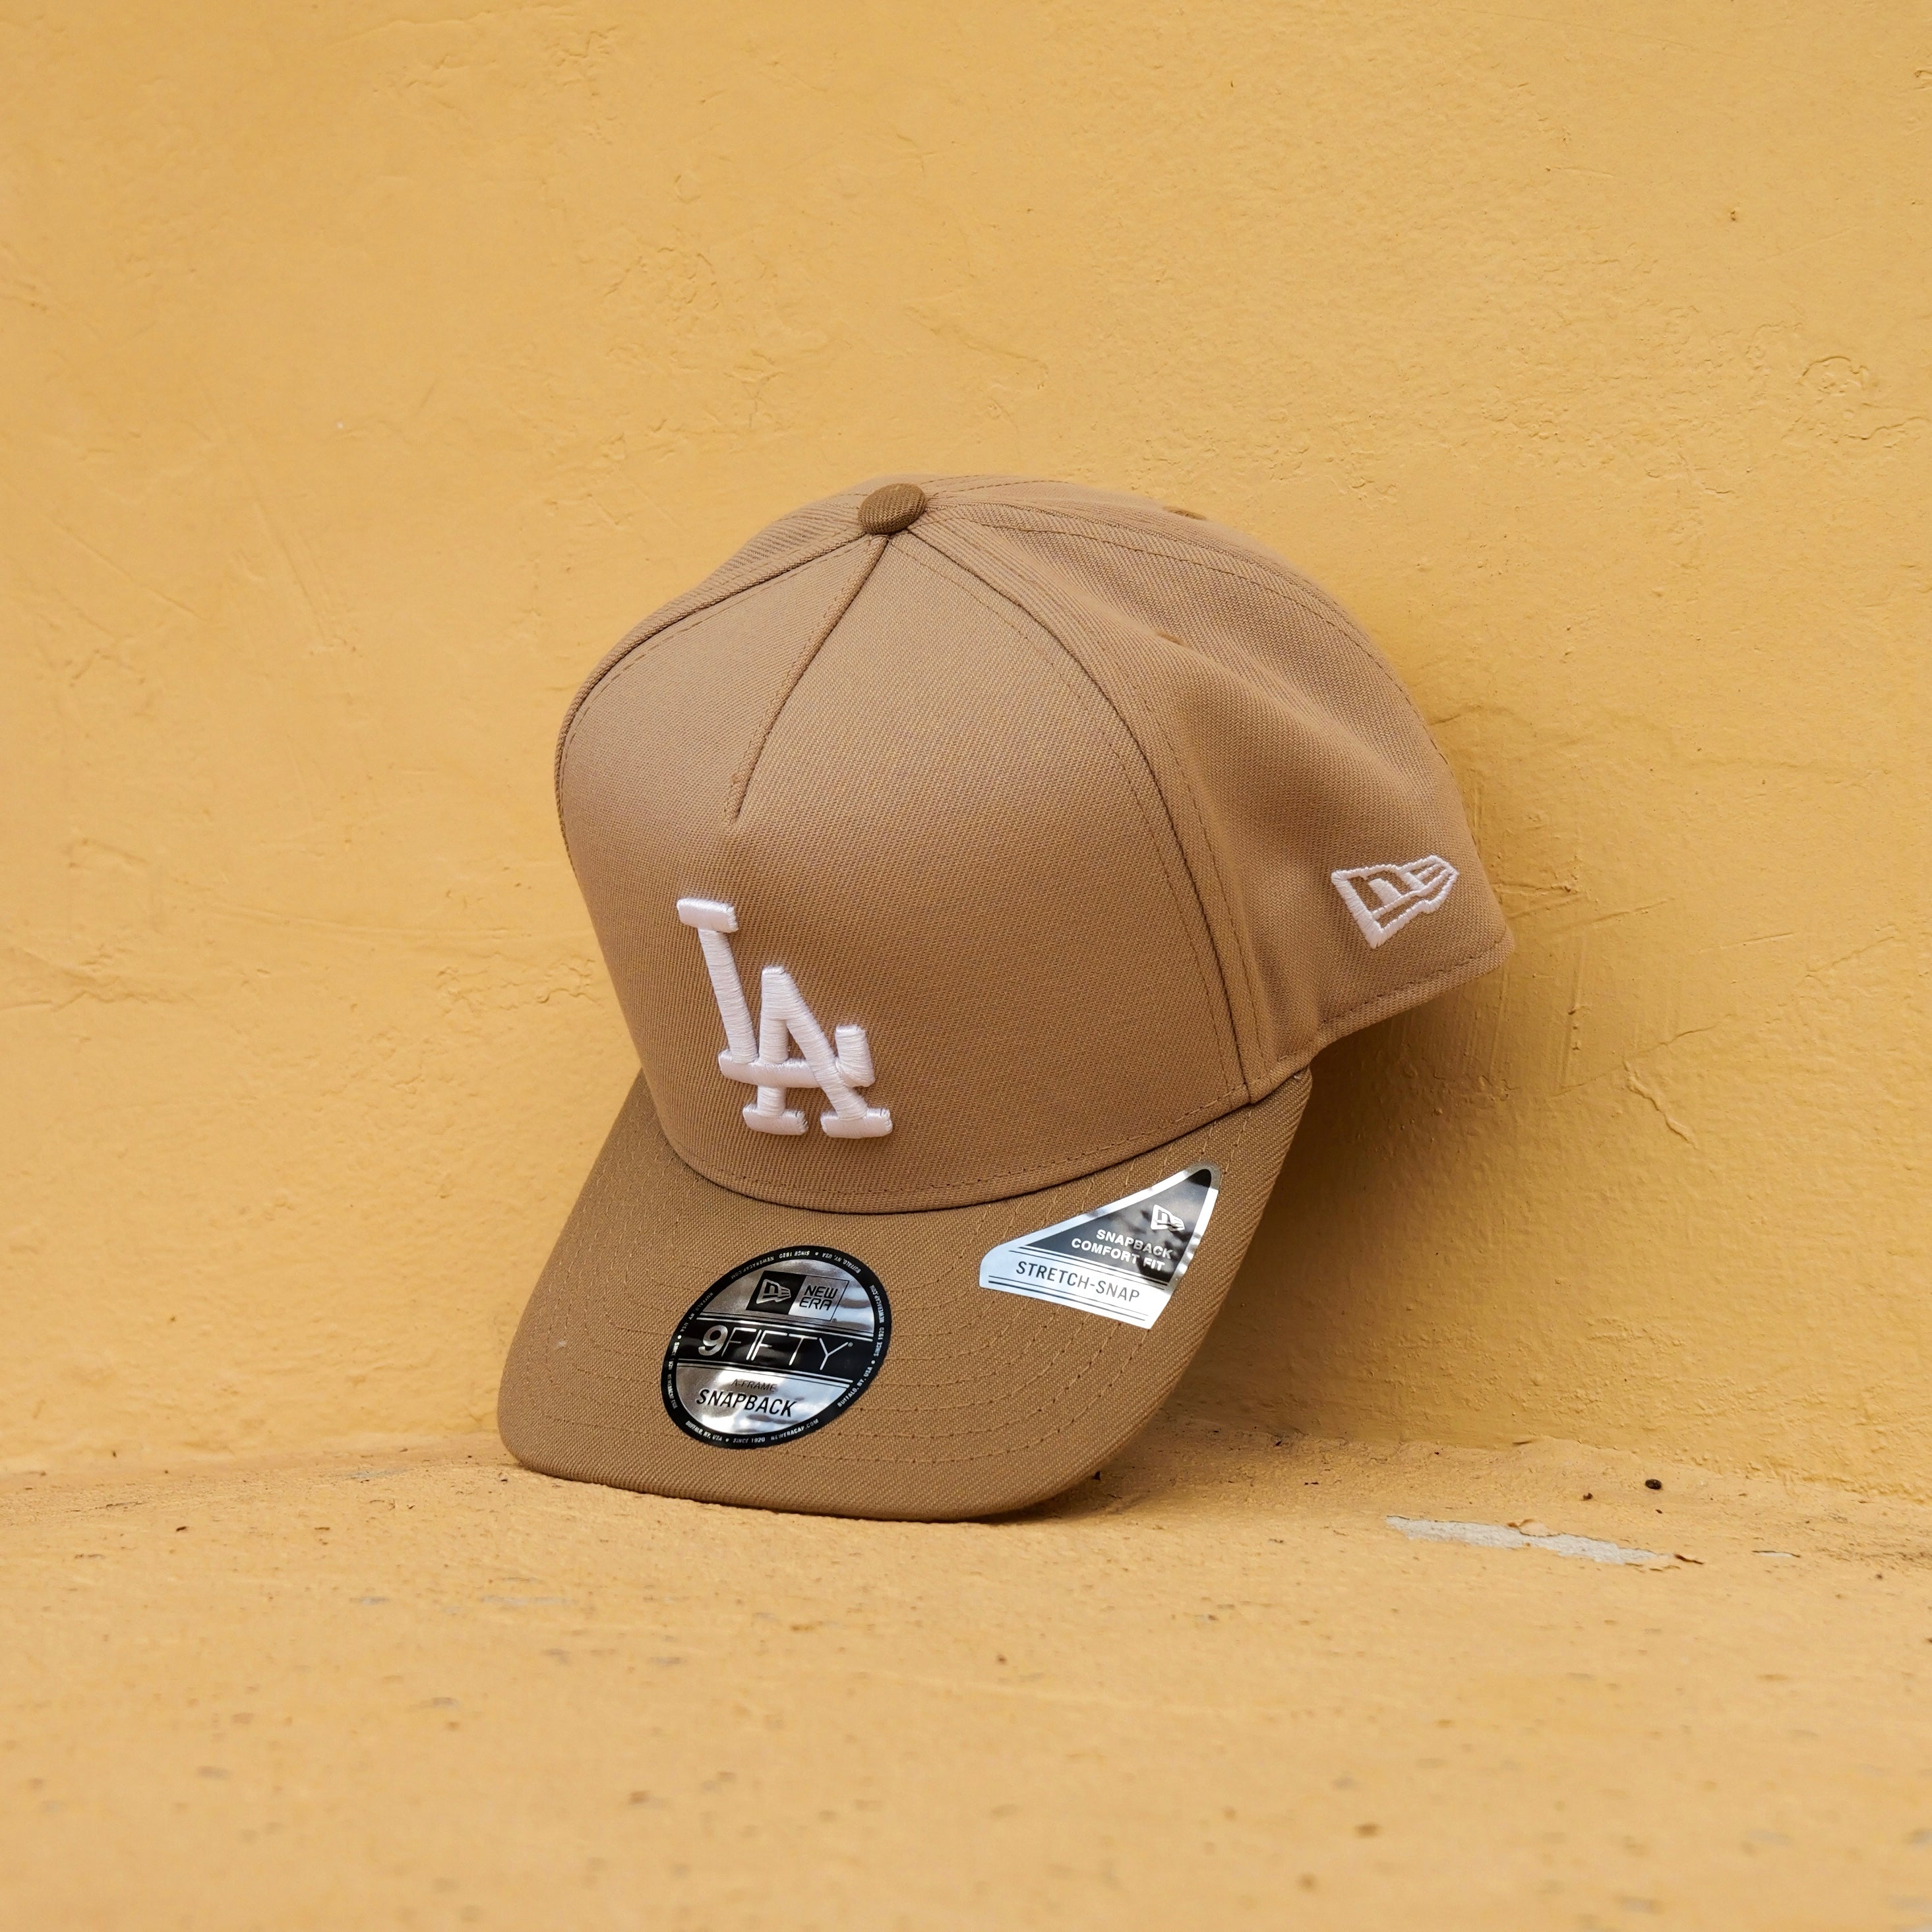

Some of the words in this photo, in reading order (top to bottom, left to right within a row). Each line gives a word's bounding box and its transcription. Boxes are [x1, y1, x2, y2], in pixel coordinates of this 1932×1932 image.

[677, 898, 893, 1139] LA
[1072, 1238, 1140, 1265] COMFORT
[1143, 1257, 1166, 1271] FIT
[1097, 1229, 1172, 1259] SNAPBACK
[804, 1285, 839, 1300] NEW
[1015, 1261, 1140, 1302] STRETCH-SNAP
[799, 1298, 833, 1312] ERA
[863, 1366, 873, 1377] USA
[873, 1341, 883, 1357] SINCE
[731, 1378, 778, 1392] A-FRAME
[696, 1389, 797, 1418] SNAPBACK
